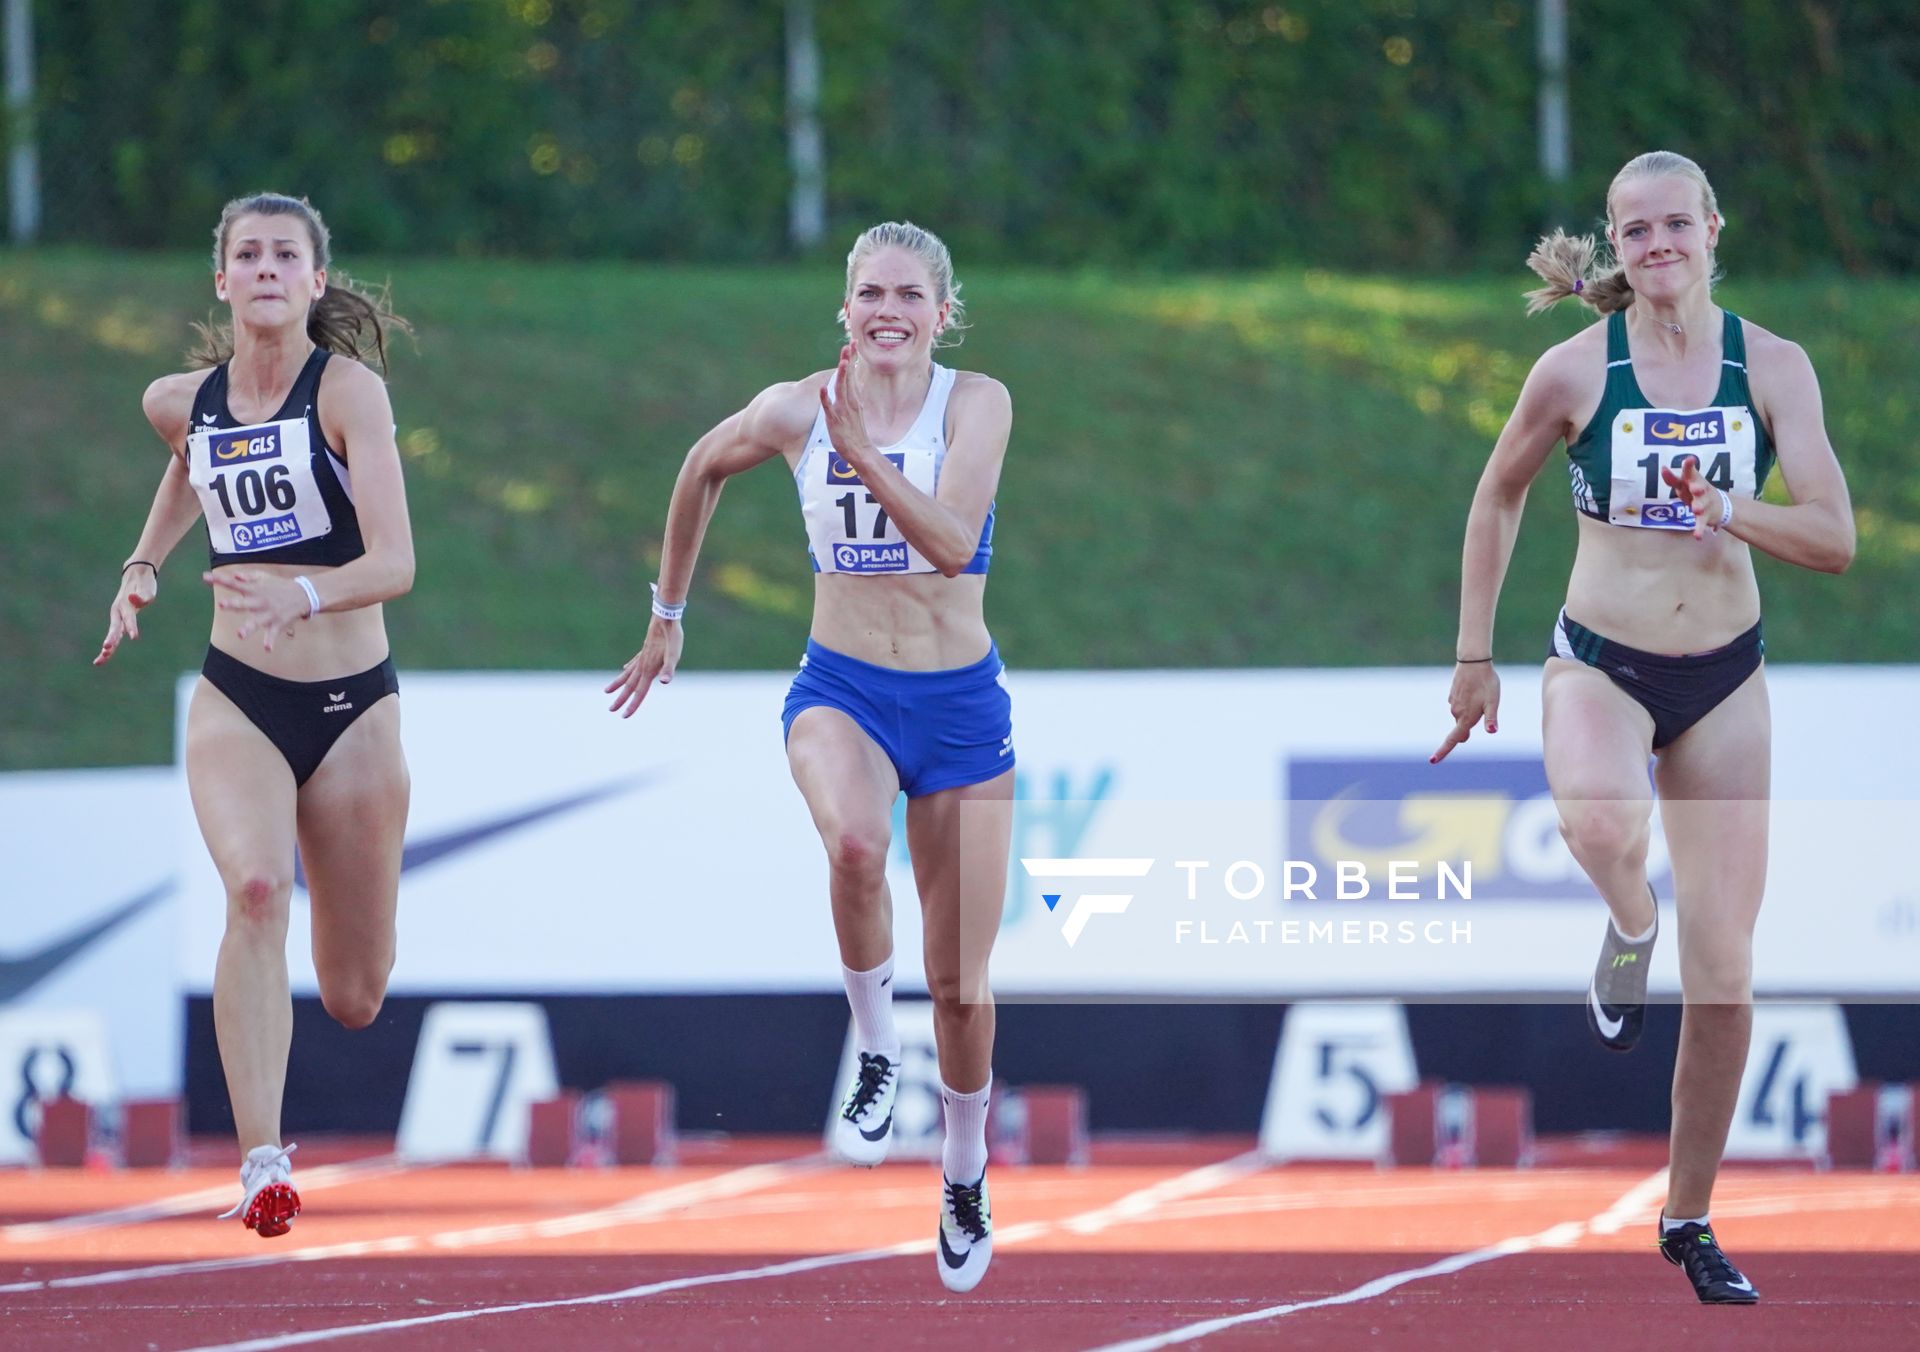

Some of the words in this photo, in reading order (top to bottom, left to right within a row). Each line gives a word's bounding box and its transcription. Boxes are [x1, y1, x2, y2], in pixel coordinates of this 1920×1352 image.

[1686, 420, 1718, 440] GLS
[249, 435, 275, 455] GLS
[209, 464, 296, 518] 106
[836, 492, 889, 538] 17
[1677, 505, 1693, 519] PL
[253, 518, 296, 538] PLAN
[861, 548, 905, 561] PLAN
[324, 702, 352, 713] erima
[1318, 1035, 1378, 1134] 5
[1752, 1038, 1820, 1142] 4
[451, 1042, 514, 1148] 7
